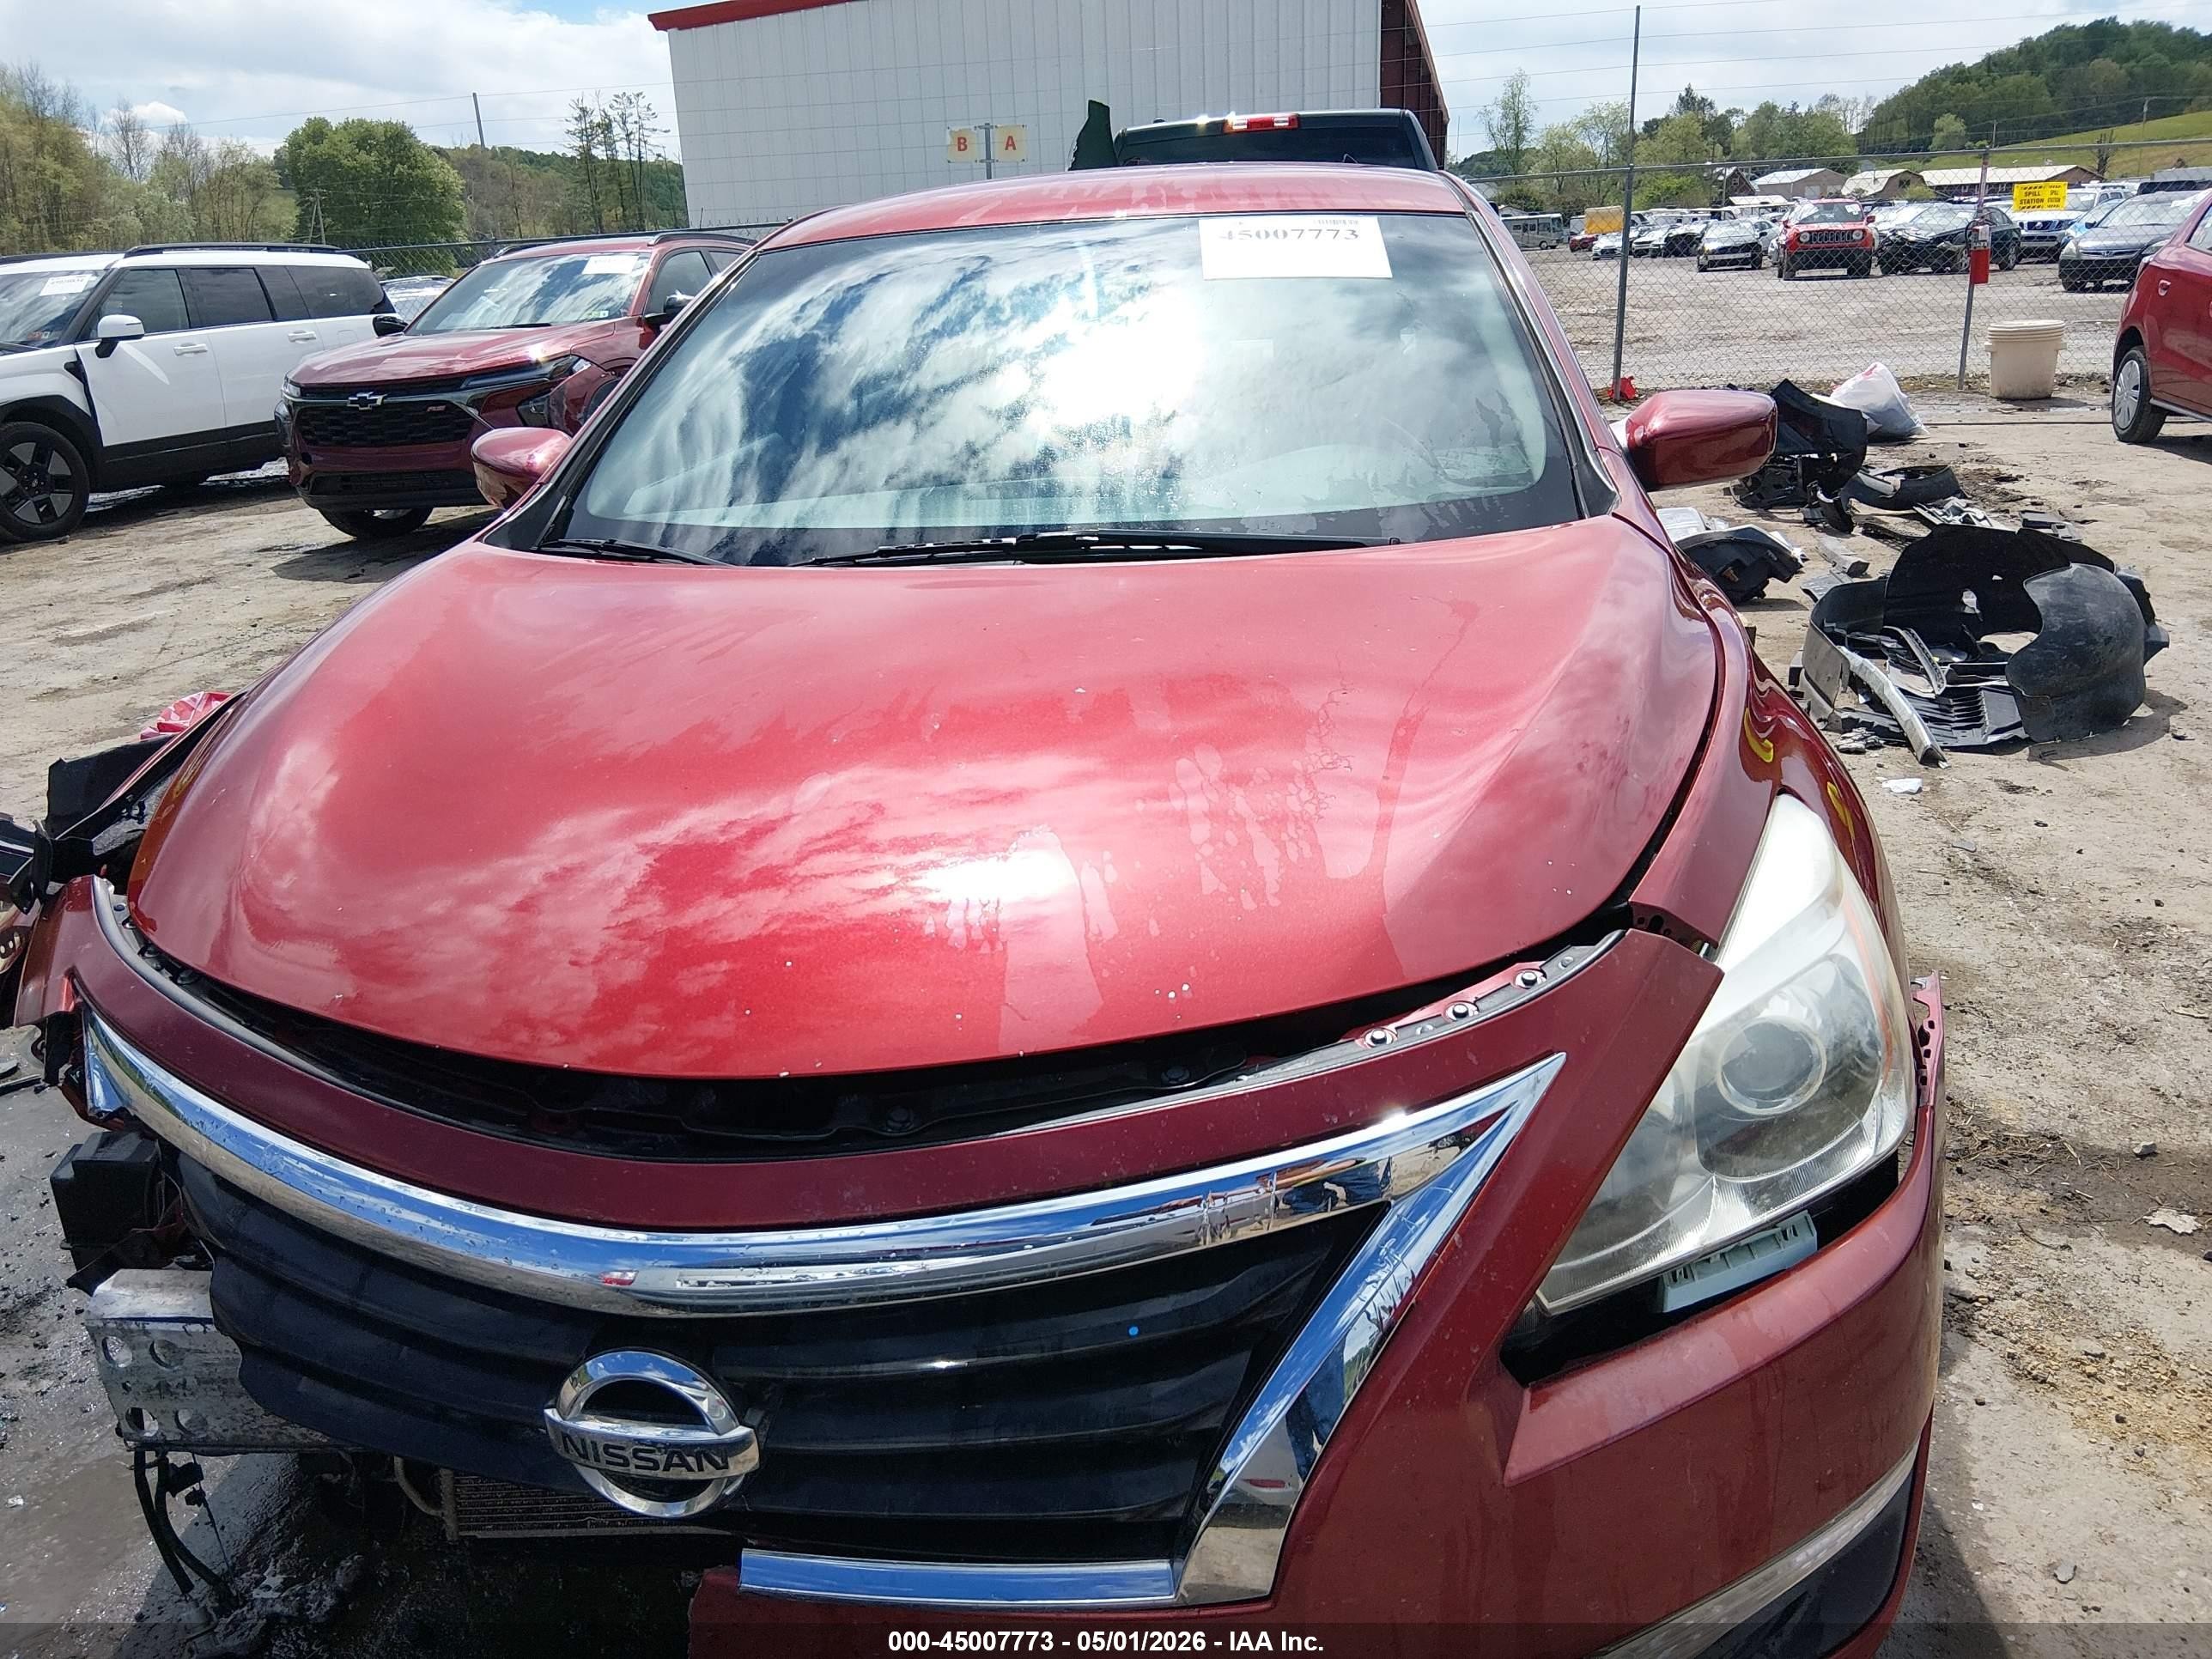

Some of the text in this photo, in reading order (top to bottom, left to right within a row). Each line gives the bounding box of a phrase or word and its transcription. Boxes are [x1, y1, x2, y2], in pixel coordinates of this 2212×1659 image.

[957, 137, 968, 152] B
[1004, 135, 1017, 151] A
[1218, 228, 1359, 240] 45007773
[562, 1431, 730, 1473] NISSAN
